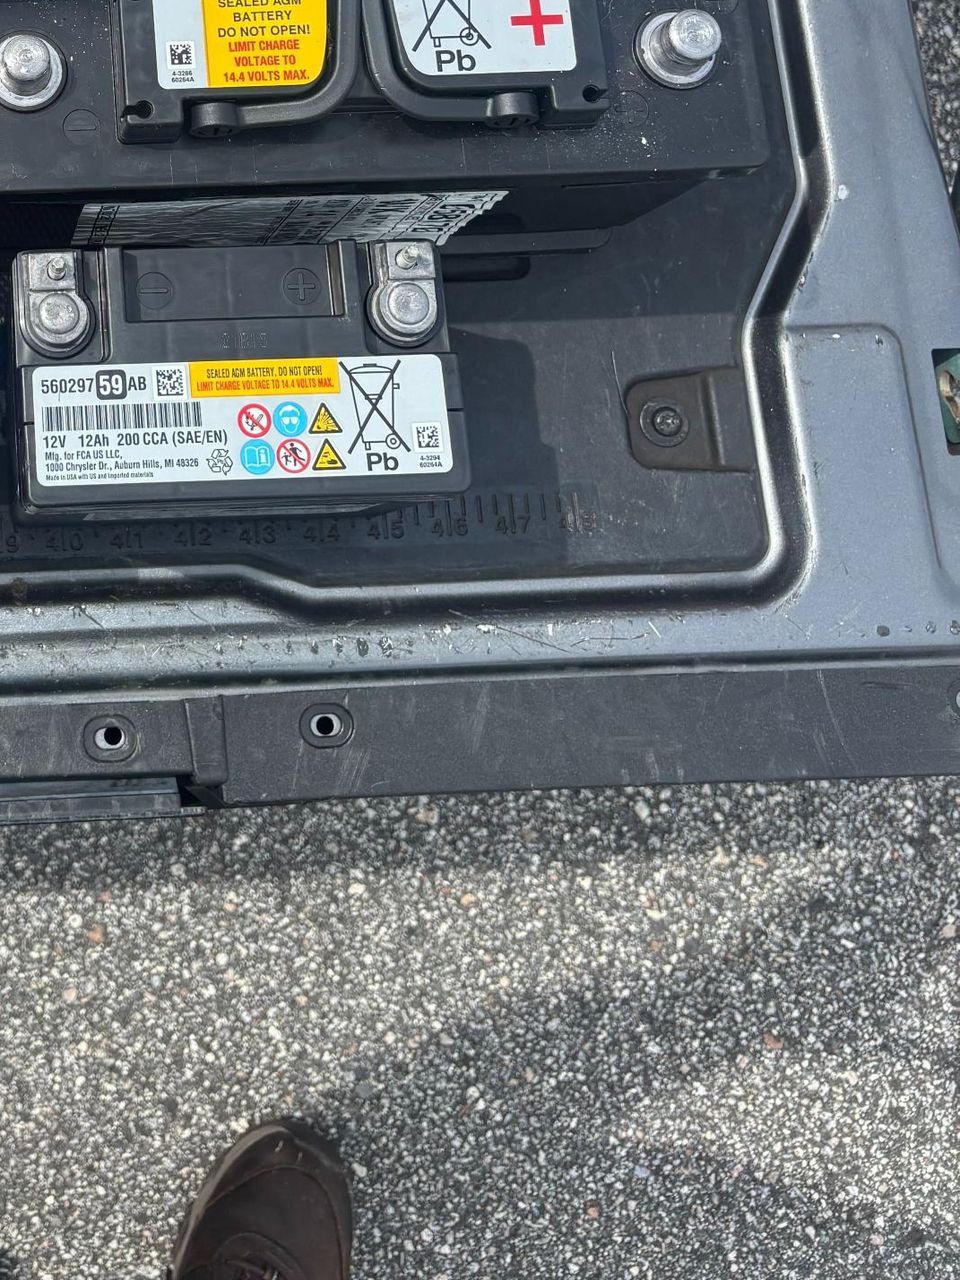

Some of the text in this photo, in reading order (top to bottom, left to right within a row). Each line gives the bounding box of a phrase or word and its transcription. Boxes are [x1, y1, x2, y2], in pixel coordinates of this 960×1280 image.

[232, 11, 292, 22] BATTERY
[217, 24, 310, 38] DO NOT OPEN!
[228, 39, 299, 52] LIMIT CHARGE
[234, 54, 296, 67] VOLTAGE TO
[436, 49, 476, 72] Pb
[223, 69, 309, 82] 14.4 VOLTS MAX.
[40, 373, 147, 396] 560297 59 AB
[42, 428, 228, 448] 12V 12Ah 200 CCA (SAE/EN)
[367, 452, 399, 471] Pb
